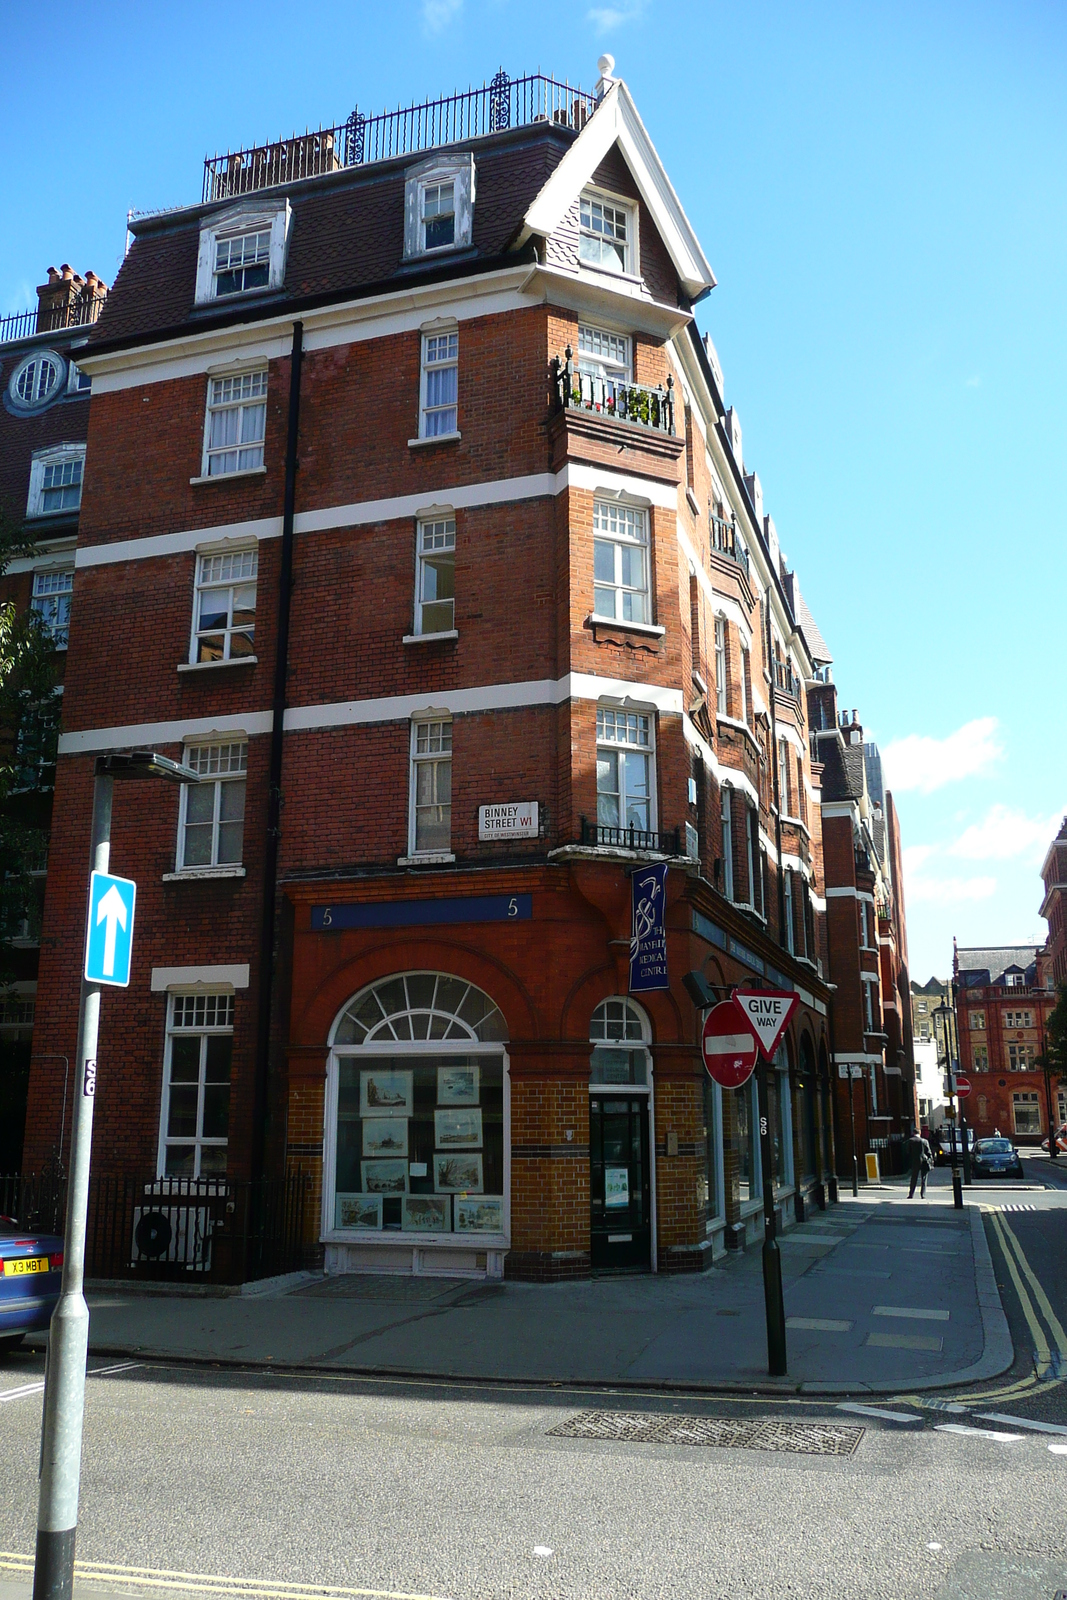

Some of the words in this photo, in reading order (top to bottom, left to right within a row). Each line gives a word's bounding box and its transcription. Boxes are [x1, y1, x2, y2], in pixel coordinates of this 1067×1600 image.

[484, 806, 518, 818] BINNEY
[484, 818, 517, 829] STREET
[520, 816, 532, 827] W1
[507, 898, 518, 917] 5
[322, 908, 333, 926] 5
[640, 966, 667, 978] CENTRE
[748, 999, 782, 1015] GIVE
[756, 1017, 777, 1028] WAY
[12, 1262, 24, 1273] X3
[26, 1259, 42, 1272] MBT
